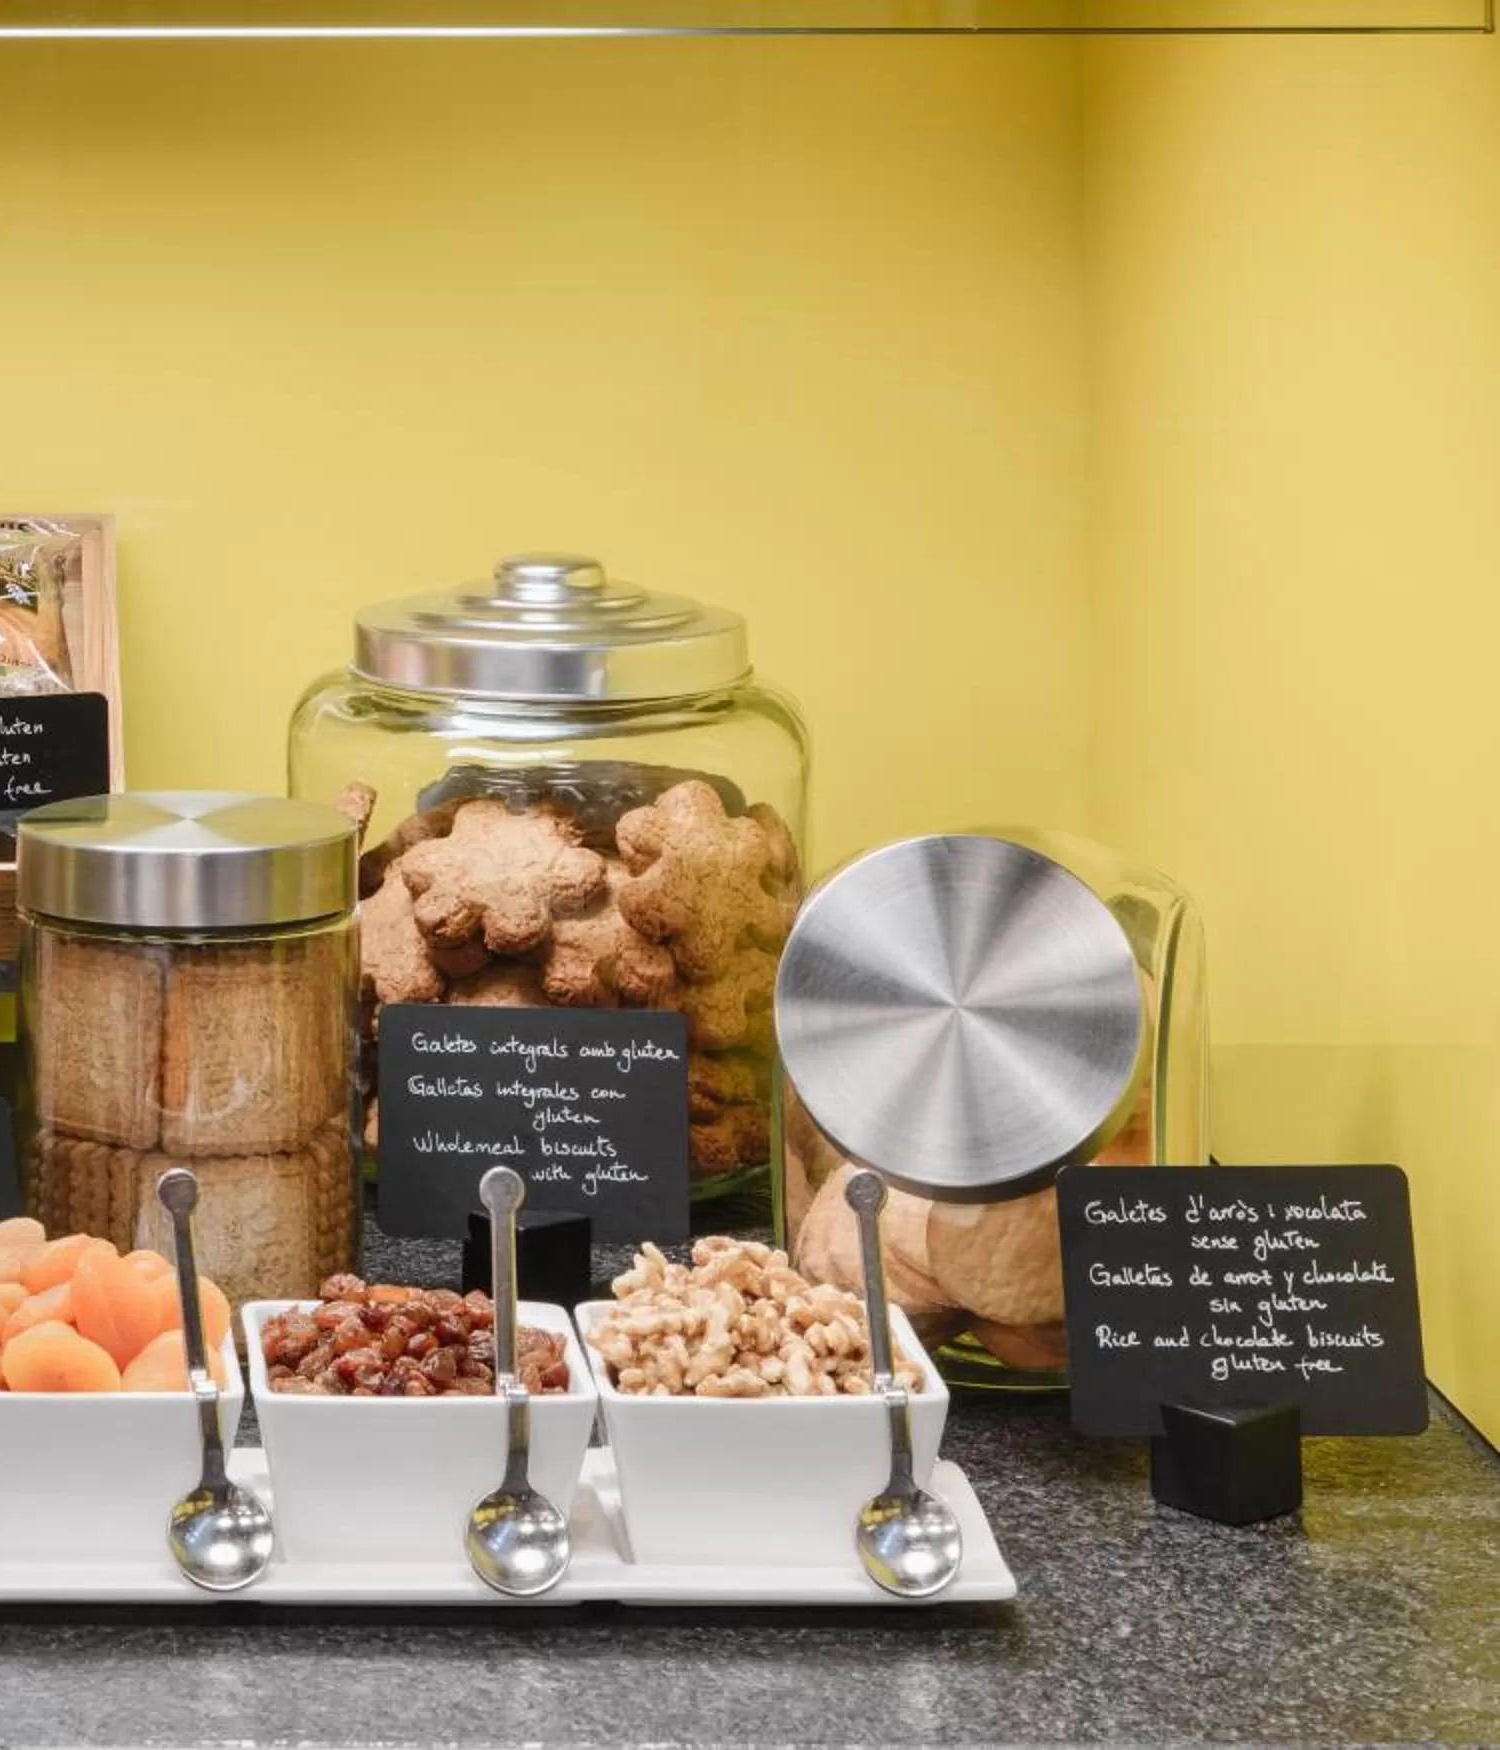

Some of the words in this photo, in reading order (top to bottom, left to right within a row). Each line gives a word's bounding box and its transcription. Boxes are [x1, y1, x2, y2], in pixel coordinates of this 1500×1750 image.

[4, 776, 52, 801] free
[412, 1032, 477, 1054] Galetes
[489, 1035, 568, 1073] integrals
[579, 1041, 616, 1057] amb
[617, 1039, 680, 1072] gluten
[408, 1074, 483, 1098] Galletas
[496, 1079, 580, 1108] integrales
[591, 1088, 626, 1099] con
[533, 1106, 600, 1131] gluten
[412, 1130, 525, 1156] Wholemeal
[541, 1135, 617, 1157] biscuits
[532, 1165, 572, 1181] with
[582, 1161, 649, 1195] gluten
[1085, 1197, 1167, 1224] Galetes
[1285, 1194, 1368, 1221] xocolata
[1191, 1234, 1239, 1250] sense
[1254, 1229, 1321, 1261] gluten
[1089, 1263, 1173, 1287] Galletas
[1190, 1264, 1212, 1285] de
[1223, 1271, 1273, 1284] arroz
[1284, 1271, 1294, 1293] y
[1303, 1260, 1395, 1284] chocolate
[1209, 1298, 1243, 1313] sin
[1258, 1293, 1328, 1327] gluten
[1095, 1325, 1141, 1348] Rice
[1154, 1325, 1189, 1348] and
[1199, 1325, 1294, 1348] chocolate
[1307, 1325, 1384, 1348] biscuits
[1212, 1356, 1286, 1381] gluten
[1294, 1356, 1344, 1381] free
